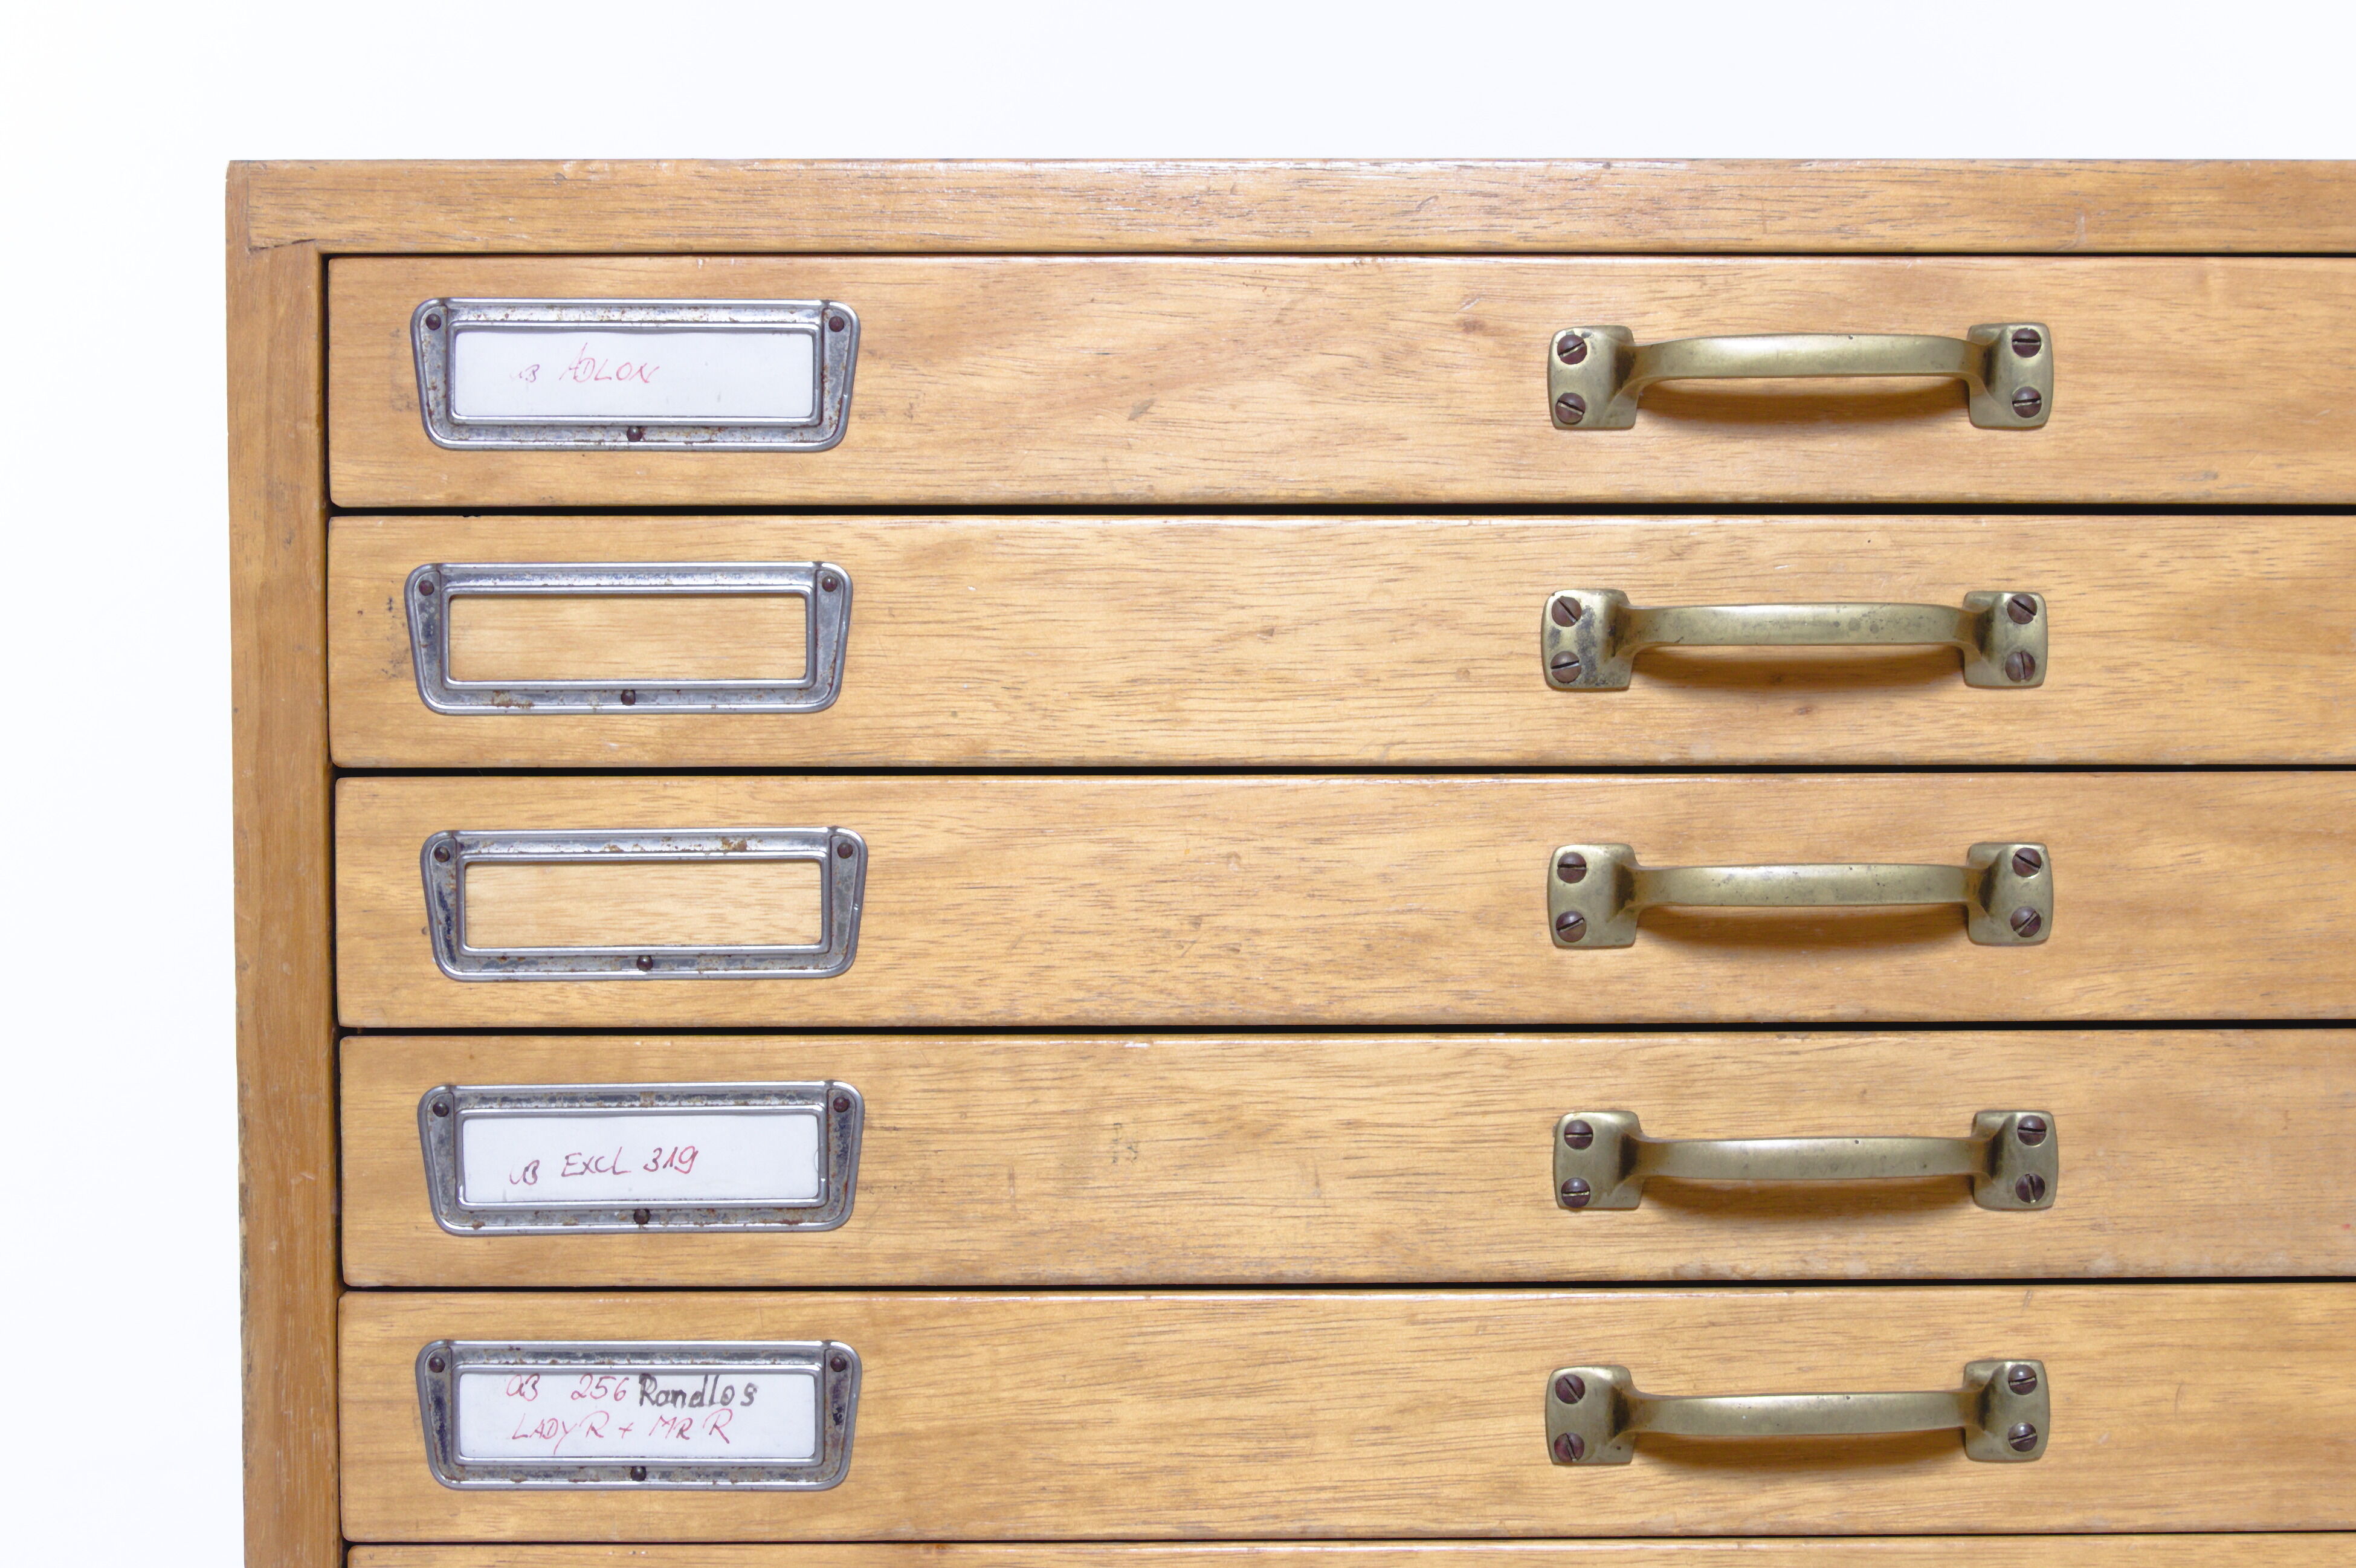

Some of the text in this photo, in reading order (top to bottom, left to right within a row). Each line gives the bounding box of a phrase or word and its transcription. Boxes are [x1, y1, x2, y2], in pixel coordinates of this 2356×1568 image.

[643, 1145, 699, 1175] 319
[570, 1372, 629, 1402] 256
[702, 1408, 734, 1444] R
